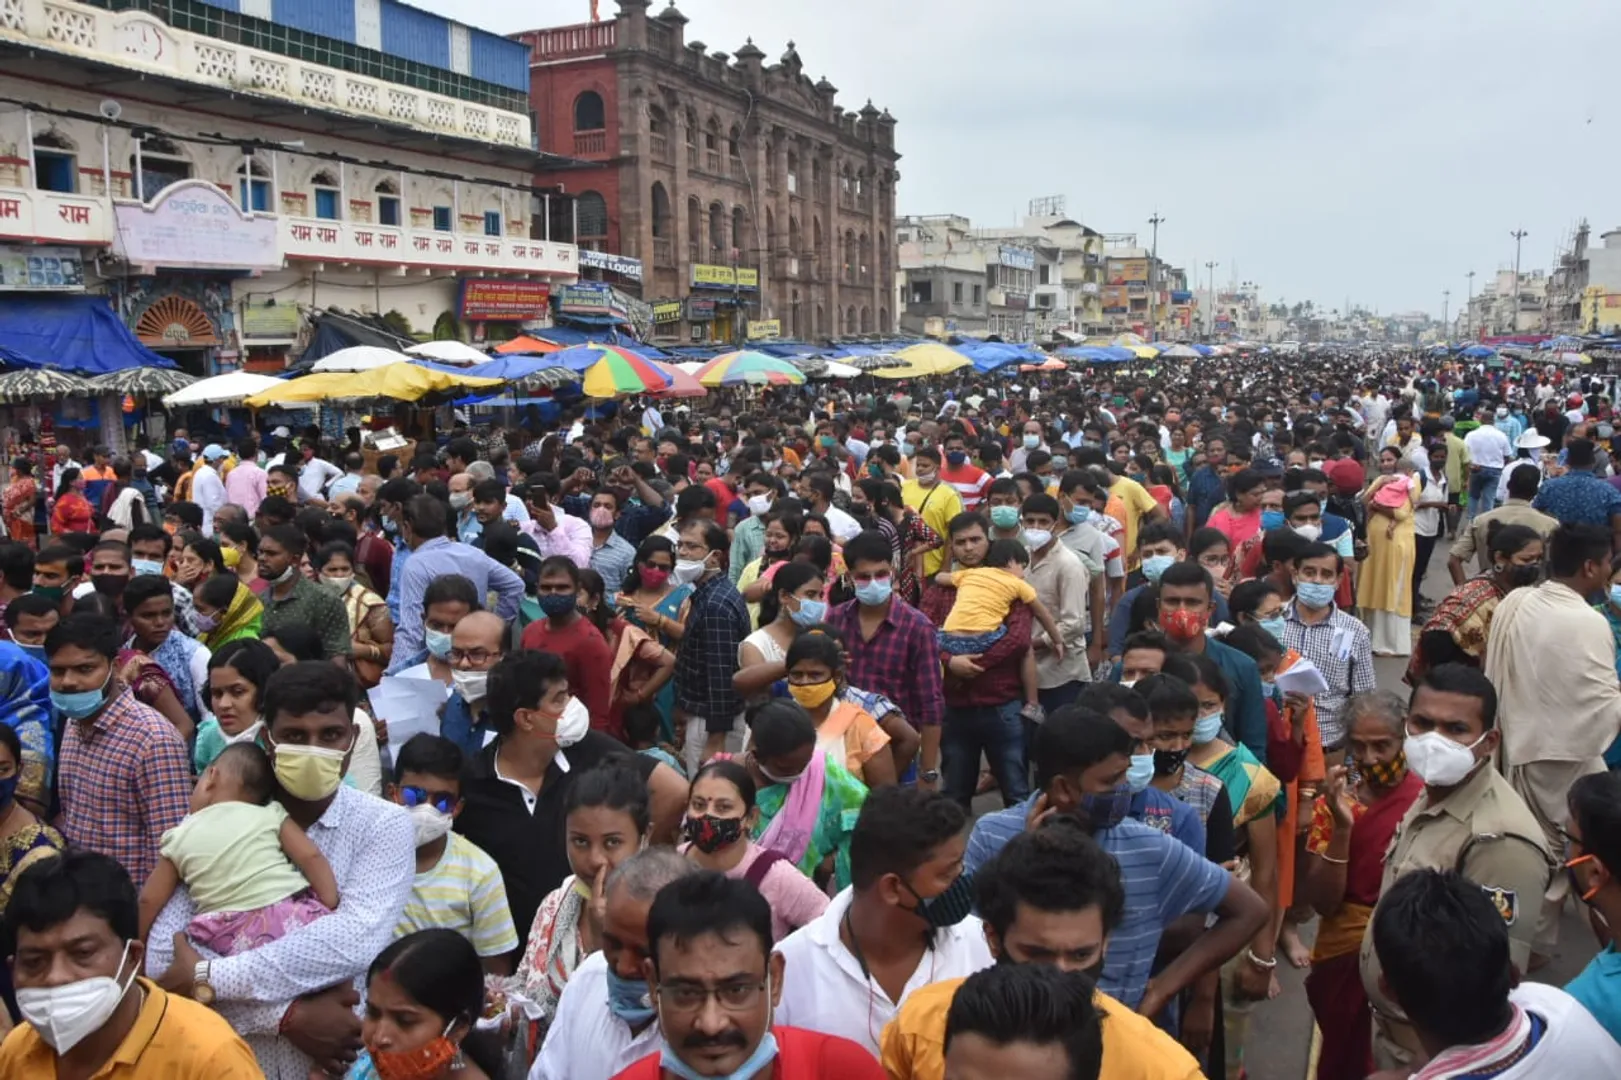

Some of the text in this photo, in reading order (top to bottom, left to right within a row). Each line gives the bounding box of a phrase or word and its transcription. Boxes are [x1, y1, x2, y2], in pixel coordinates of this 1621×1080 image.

[58, 204, 91, 224] राम
[291, 225, 312, 243] राम
[316, 227, 337, 243] राम
[354, 231, 374, 247] राम
[379, 233, 397, 248] राम
[412, 236, 432, 252] राम
[436, 239, 453, 253] राम
[464, 241, 480, 254] राम
[484, 243, 500, 256] राम
[608, 261, 643, 276] LODGE
